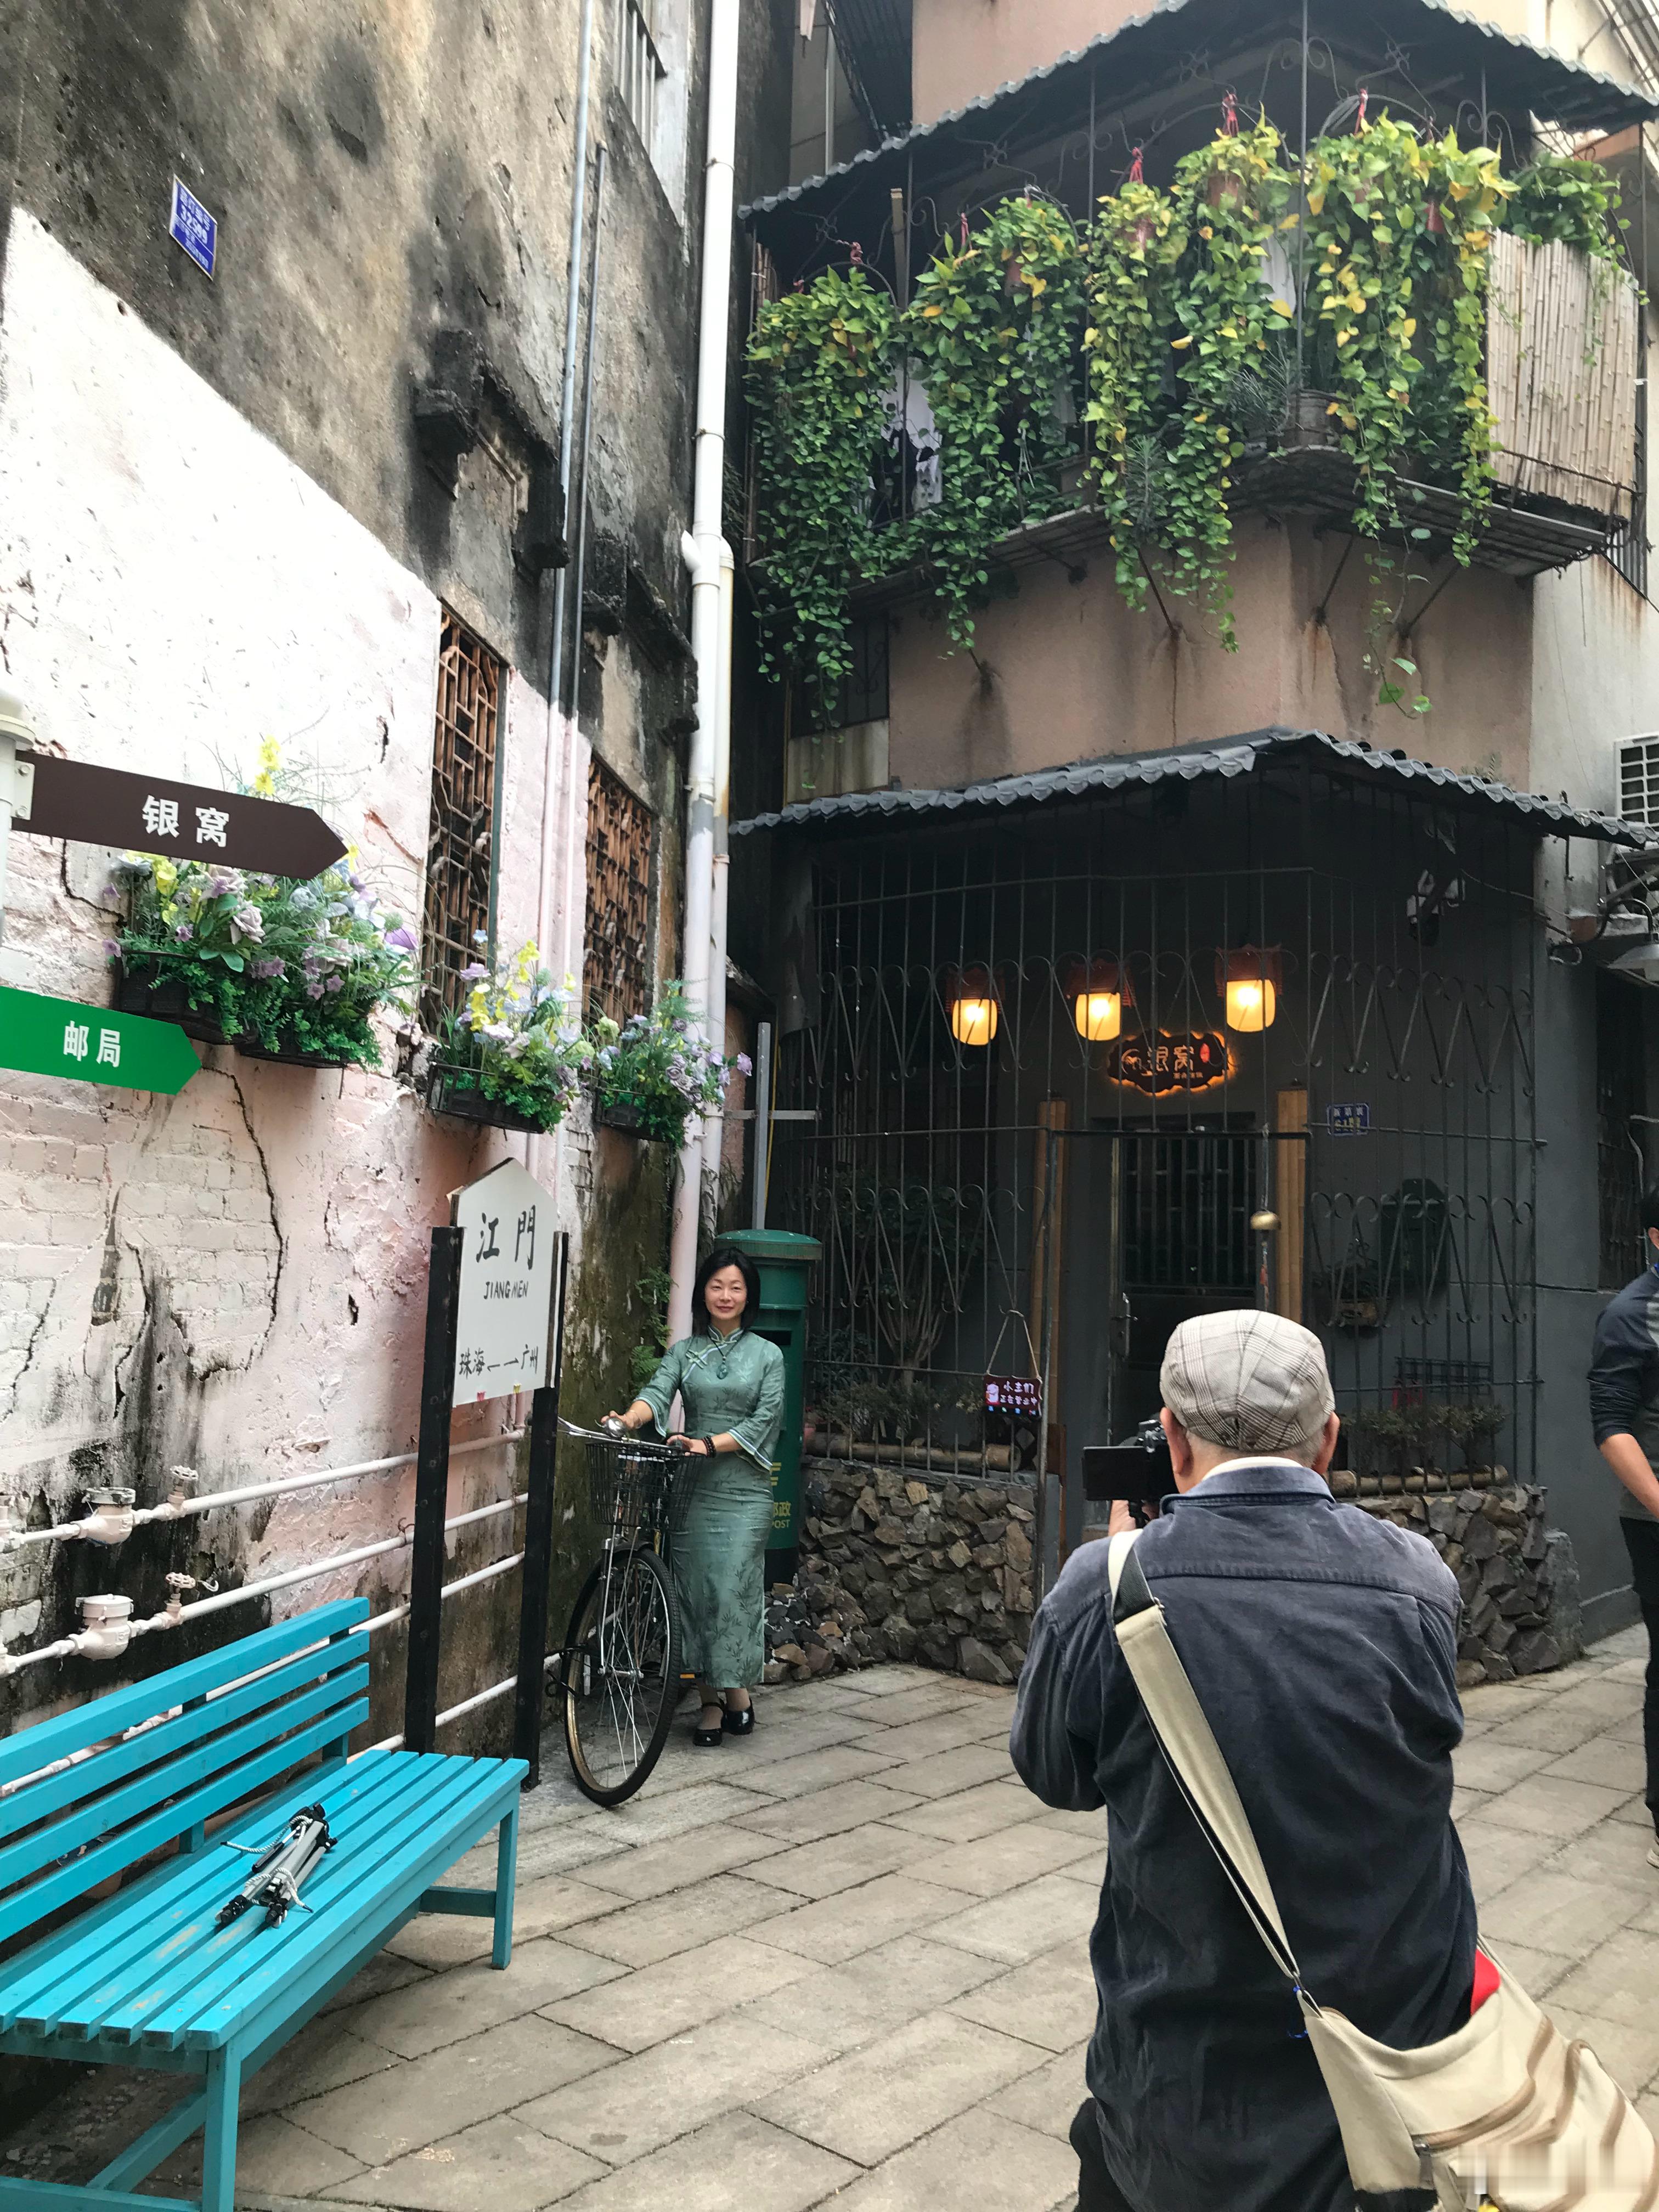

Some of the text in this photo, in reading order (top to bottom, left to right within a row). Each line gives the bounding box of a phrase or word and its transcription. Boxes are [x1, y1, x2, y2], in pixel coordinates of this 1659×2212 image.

[142, 794, 229, 848] 银窝
[63, 1020, 121, 1068] 邮局
[483, 1280, 529, 1300] JIANGMEN
[459, 1344, 539, 1379] 珠海 广州
[772, 1519, 790, 1528] OST
